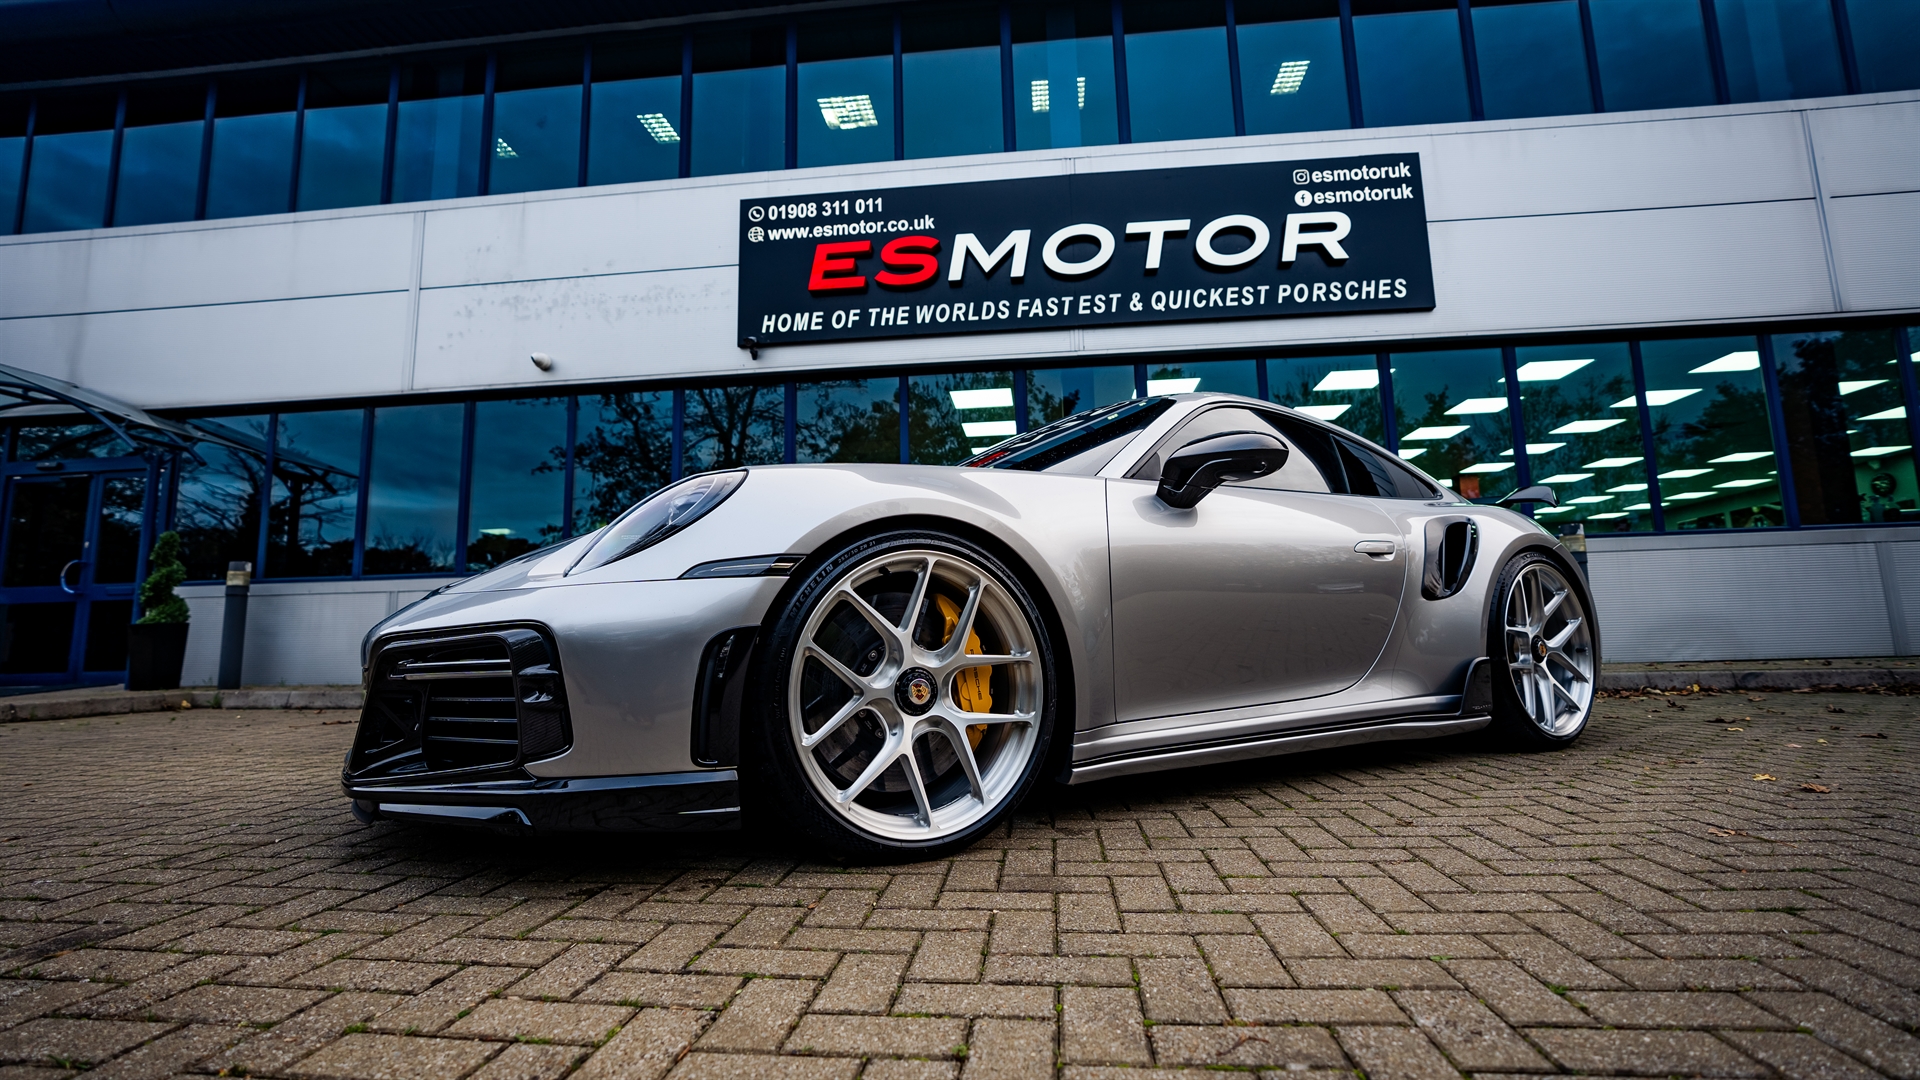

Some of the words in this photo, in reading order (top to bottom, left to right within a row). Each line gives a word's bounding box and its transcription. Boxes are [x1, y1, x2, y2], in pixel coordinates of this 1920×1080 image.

[1311, 162, 1411, 183] esmotoruk
[768, 203, 817, 221] 01908
[821, 200, 849, 217] 311
[855, 197, 883, 214] 011
[1313, 184, 1414, 204] esmotoruk
[768, 214, 935, 241] www.esmotor.co.uk
[808, 211, 1351, 292] ESMOTOR
[761, 312, 824, 333] HOME
[831, 309, 861, 329] OF
[868, 306, 910, 326] THE
[916, 300, 1010, 323] WORLDS
[1129, 292, 1143, 312] &
[1150, 285, 1270, 311] QUICKEST
[1277, 278, 1407, 303] PORSCHES
[790, 563, 834, 618] MICHELIN
[970, 649, 983, 700] PRSCHE
